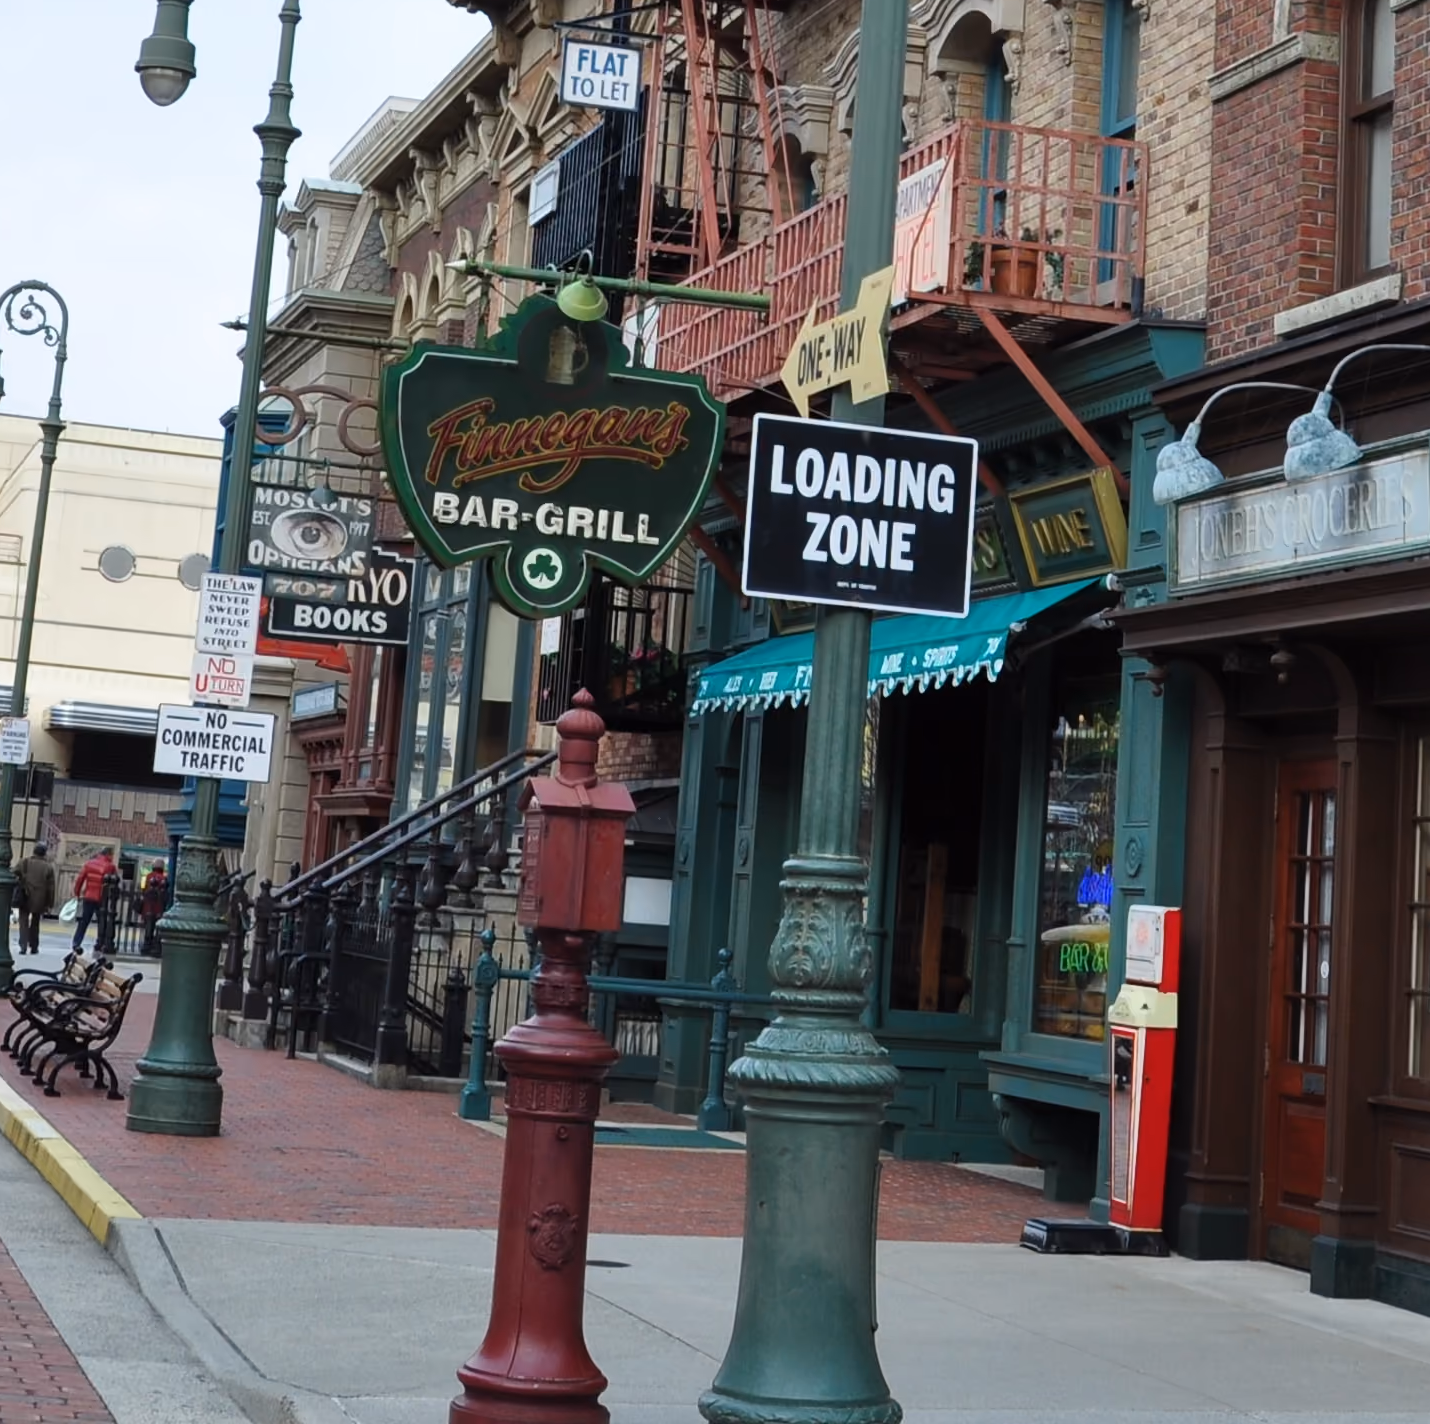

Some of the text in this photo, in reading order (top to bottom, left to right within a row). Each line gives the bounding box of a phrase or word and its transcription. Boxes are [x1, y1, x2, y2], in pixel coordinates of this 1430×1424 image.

[578, 48, 628, 77] FLAT
[571, 76, 629, 102] TO LET
[797, 316, 865, 386] ONE-WAY
[771, 444, 956, 514] LOADING
[1282, 471, 1415, 550] GROCERIES
[349, 521, 370, 537] 1917
[802, 511, 916, 571] ZONE
[248, 539, 366, 576] OPTICIANS
[206, 578, 258, 592] THE LAW
[273, 578, 337, 598] 707
[208, 605, 250, 616] SWEEP
[210, 594, 250, 605] NEVER
[204, 616, 251, 627] REFUSE
[293, 604, 387, 634] BOOKS
[203, 637, 248, 649] STREET
[214, 628, 239, 637] INTO
[208, 657, 236, 675] NO
[195, 673, 245, 694] U TURN
[206, 713, 227, 730] NO
[161, 728, 266, 754] COMMERCIAL
[181, 750, 245, 773] TRAFFIC
[1060, 943, 1090, 972] BAR
